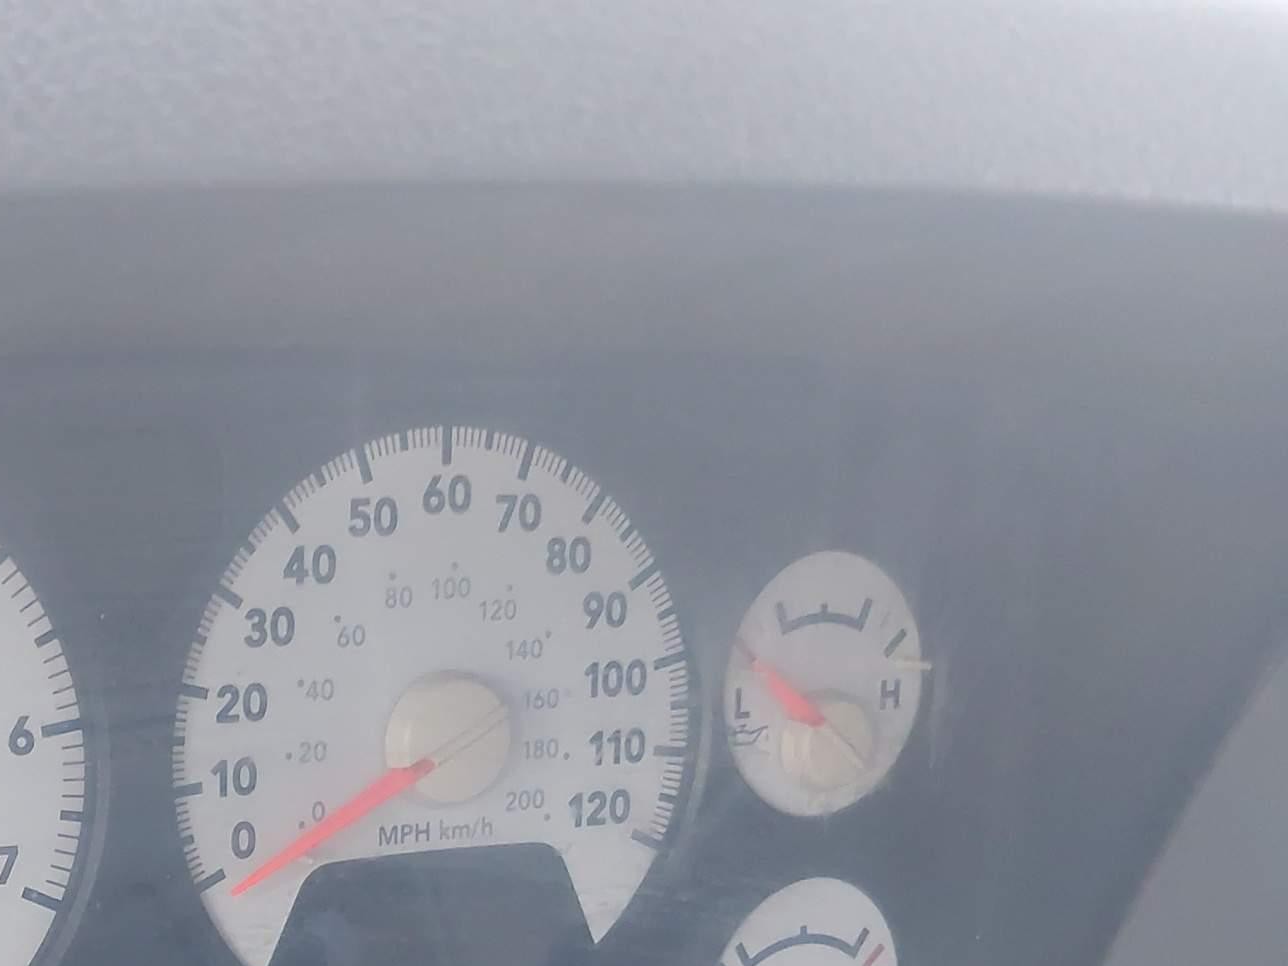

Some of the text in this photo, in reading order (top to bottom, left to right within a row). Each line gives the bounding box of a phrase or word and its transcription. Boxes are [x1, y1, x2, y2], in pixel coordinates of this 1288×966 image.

[422, 474, 472, 515] 60
[348, 497, 398, 536] 50
[495, 493, 541, 533] 70
[283, 545, 337, 585] 40
[546, 536, 591, 575] 80
[384, 586, 412, 609] 80
[431, 576, 471, 599] 100
[243, 606, 295, 648] 30
[479, 599, 517, 621] 120
[583, 592, 628, 629] 90
[337, 624, 366, 648] 60
[505, 638, 543, 660] 140
[305, 678, 334, 701] 40
[584, 659, 647, 698] 100
[880, 679, 900, 710] H
[215, 682, 268, 724] 20
[523, 688, 560, 710] 160
[734, 687, 750, 719] L
[7, 715, 35, 757] 6
[298, 740, 327, 763] 20
[523, 739, 559, 760] 180
[589, 728, 645, 766] 110
[211, 757, 257, 797] 10
[312, 801, 325, 821] 0
[505, 788, 545, 811] 200
[568, 789, 631, 828] 120
[231, 821, 256, 859] 0
[378, 816, 493, 847] MPH km/h
